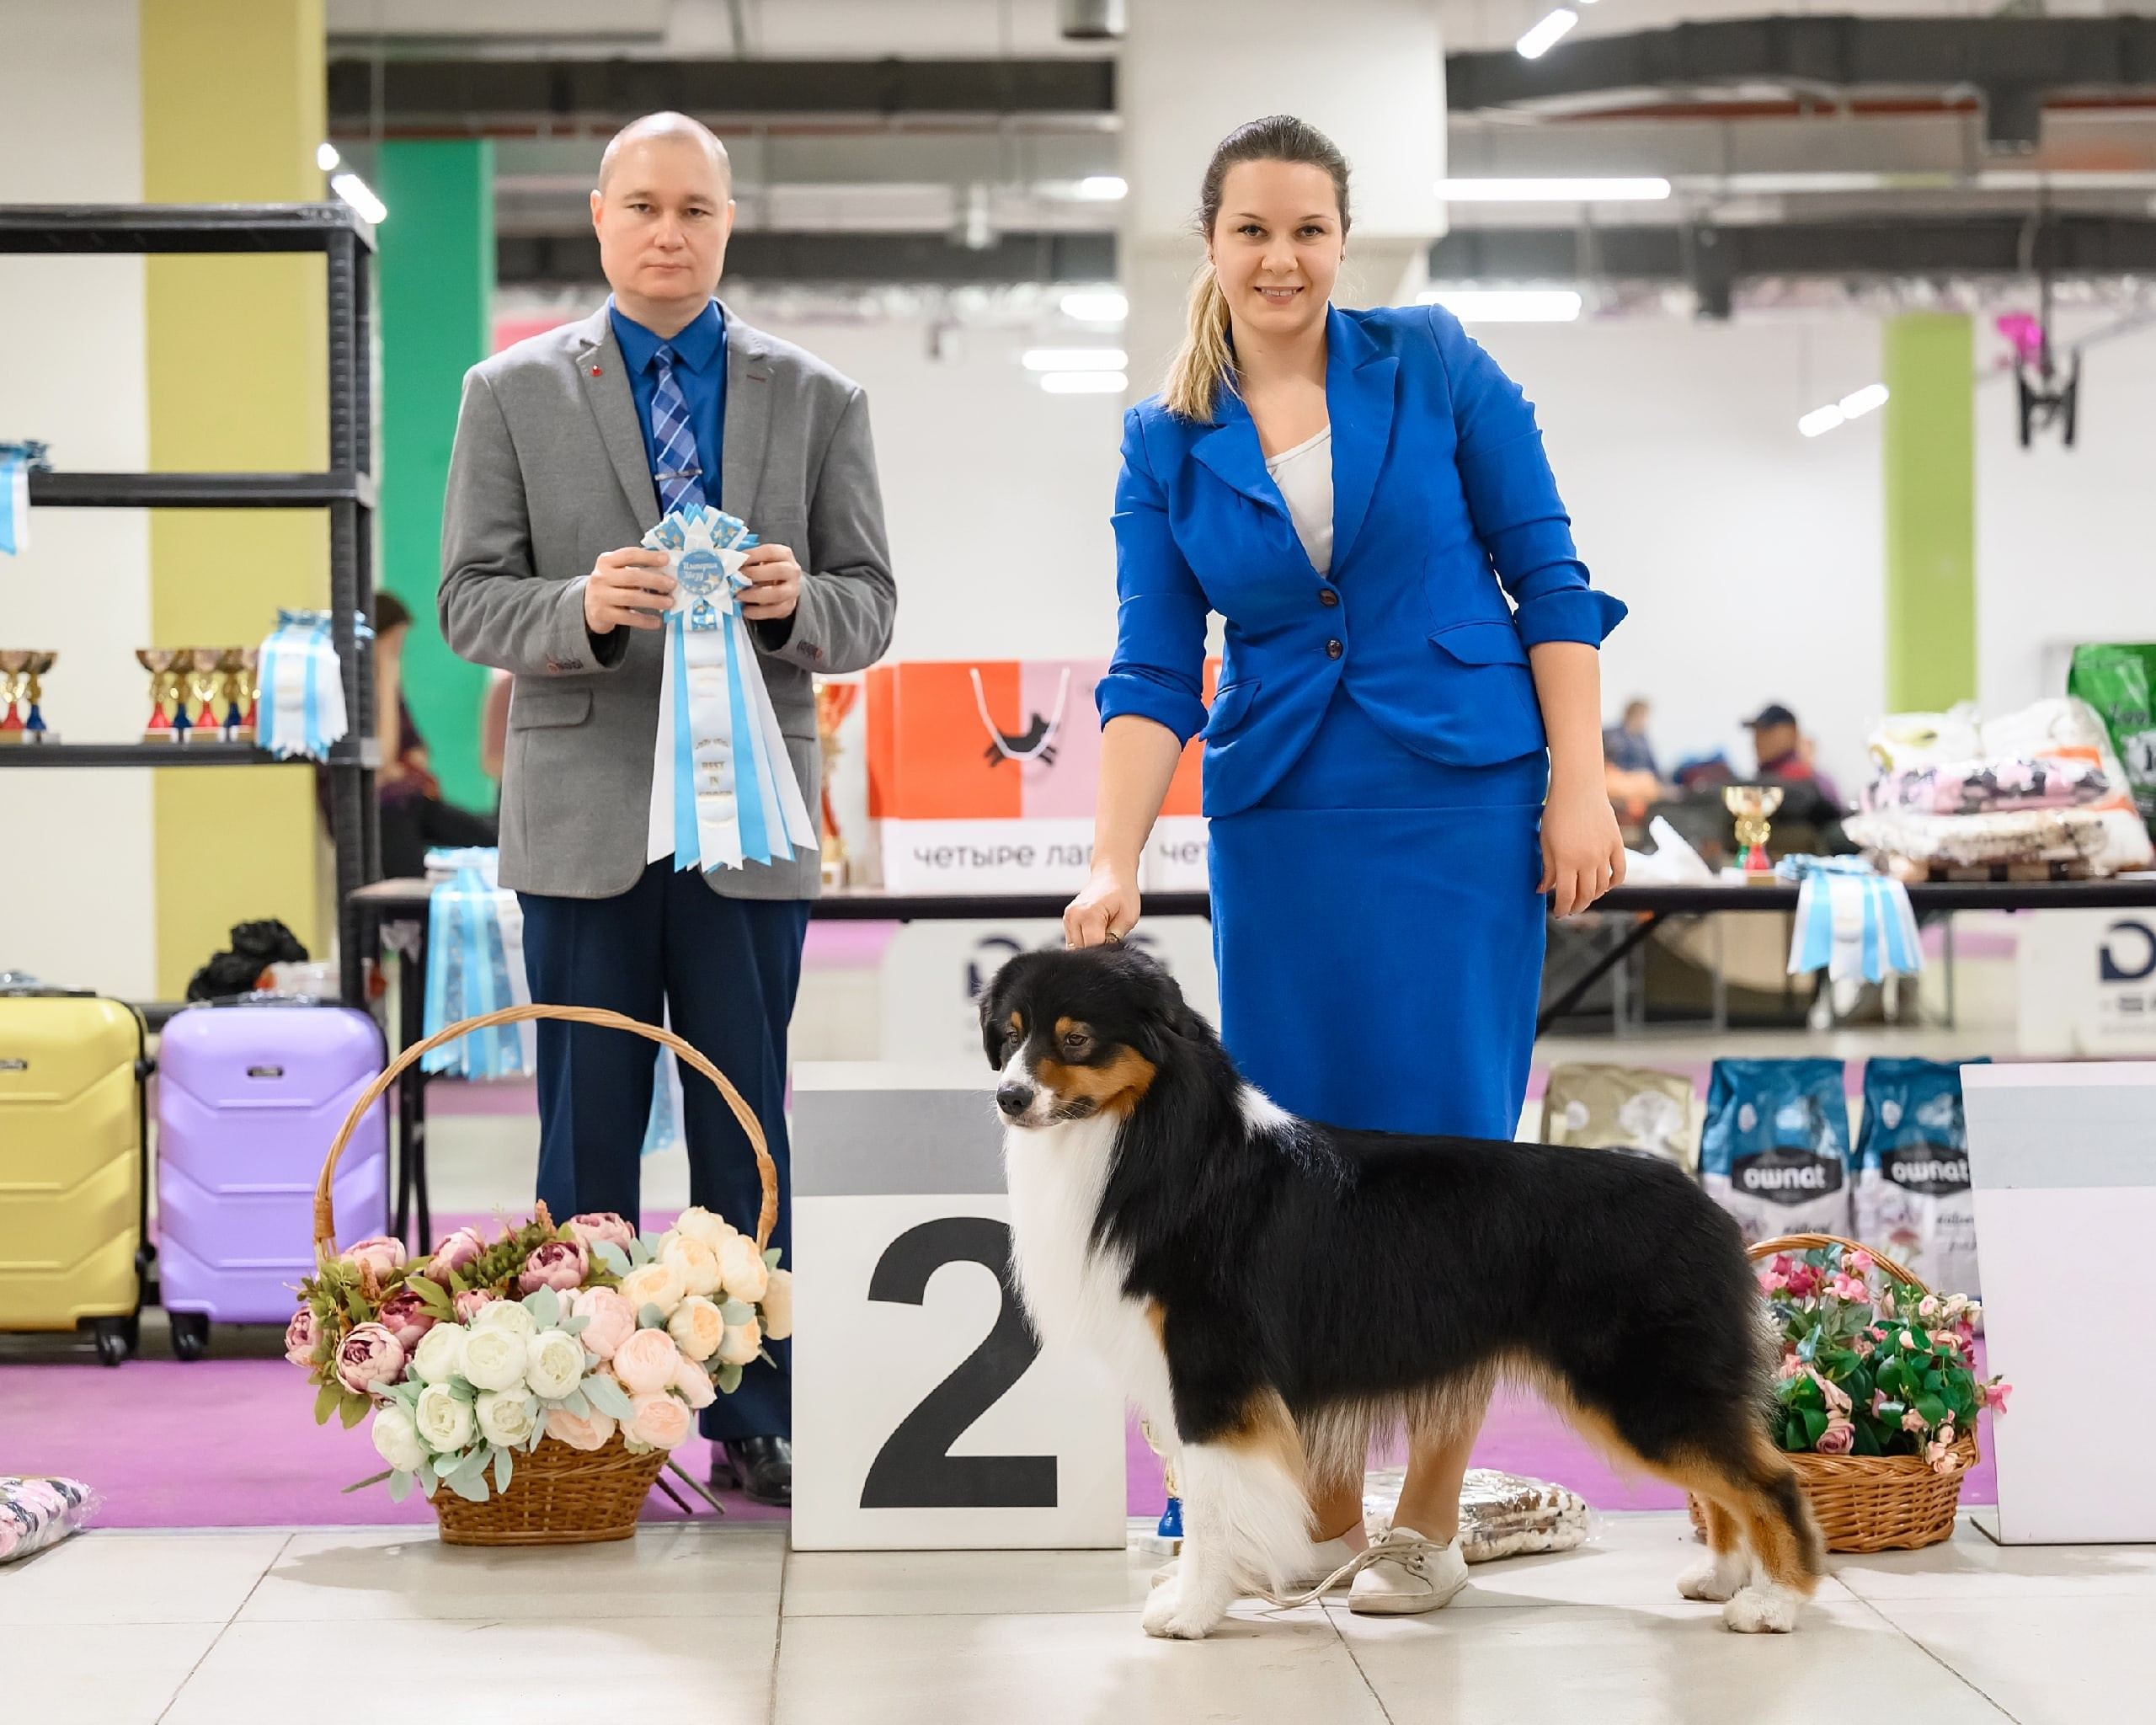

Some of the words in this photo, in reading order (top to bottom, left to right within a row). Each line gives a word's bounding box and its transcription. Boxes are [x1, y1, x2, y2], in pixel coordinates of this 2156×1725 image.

[913, 844, 1036, 868] четыре
[1743, 1164, 1826, 1189] ownat
[859, 1216, 1058, 1509] 2
